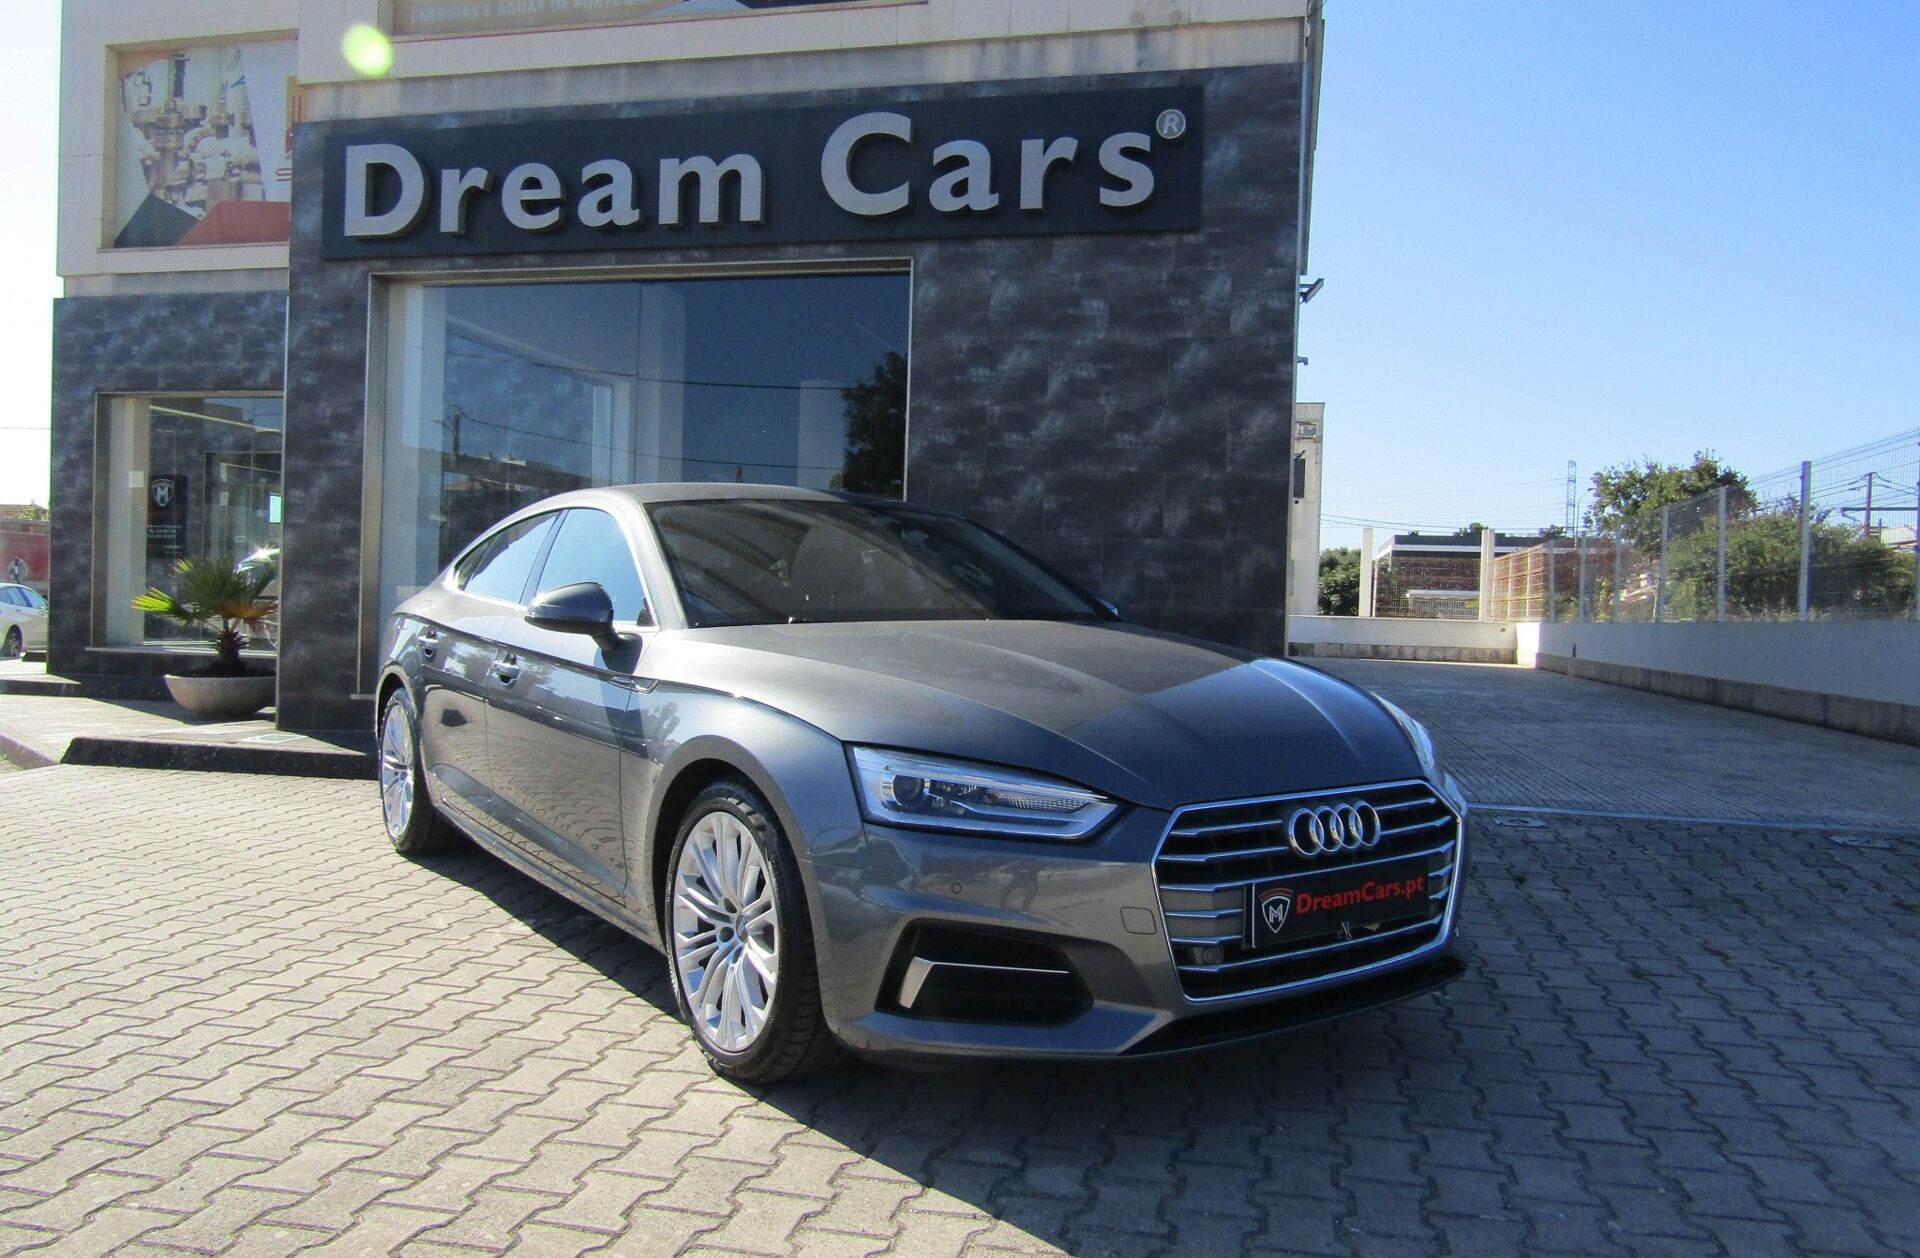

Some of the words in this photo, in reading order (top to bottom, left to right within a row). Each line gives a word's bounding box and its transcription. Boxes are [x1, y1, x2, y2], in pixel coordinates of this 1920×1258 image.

[344, 143, 765, 239] Dream
[821, 111, 1155, 216] Cars
[1296, 875, 1424, 913] DreamCars.pt
